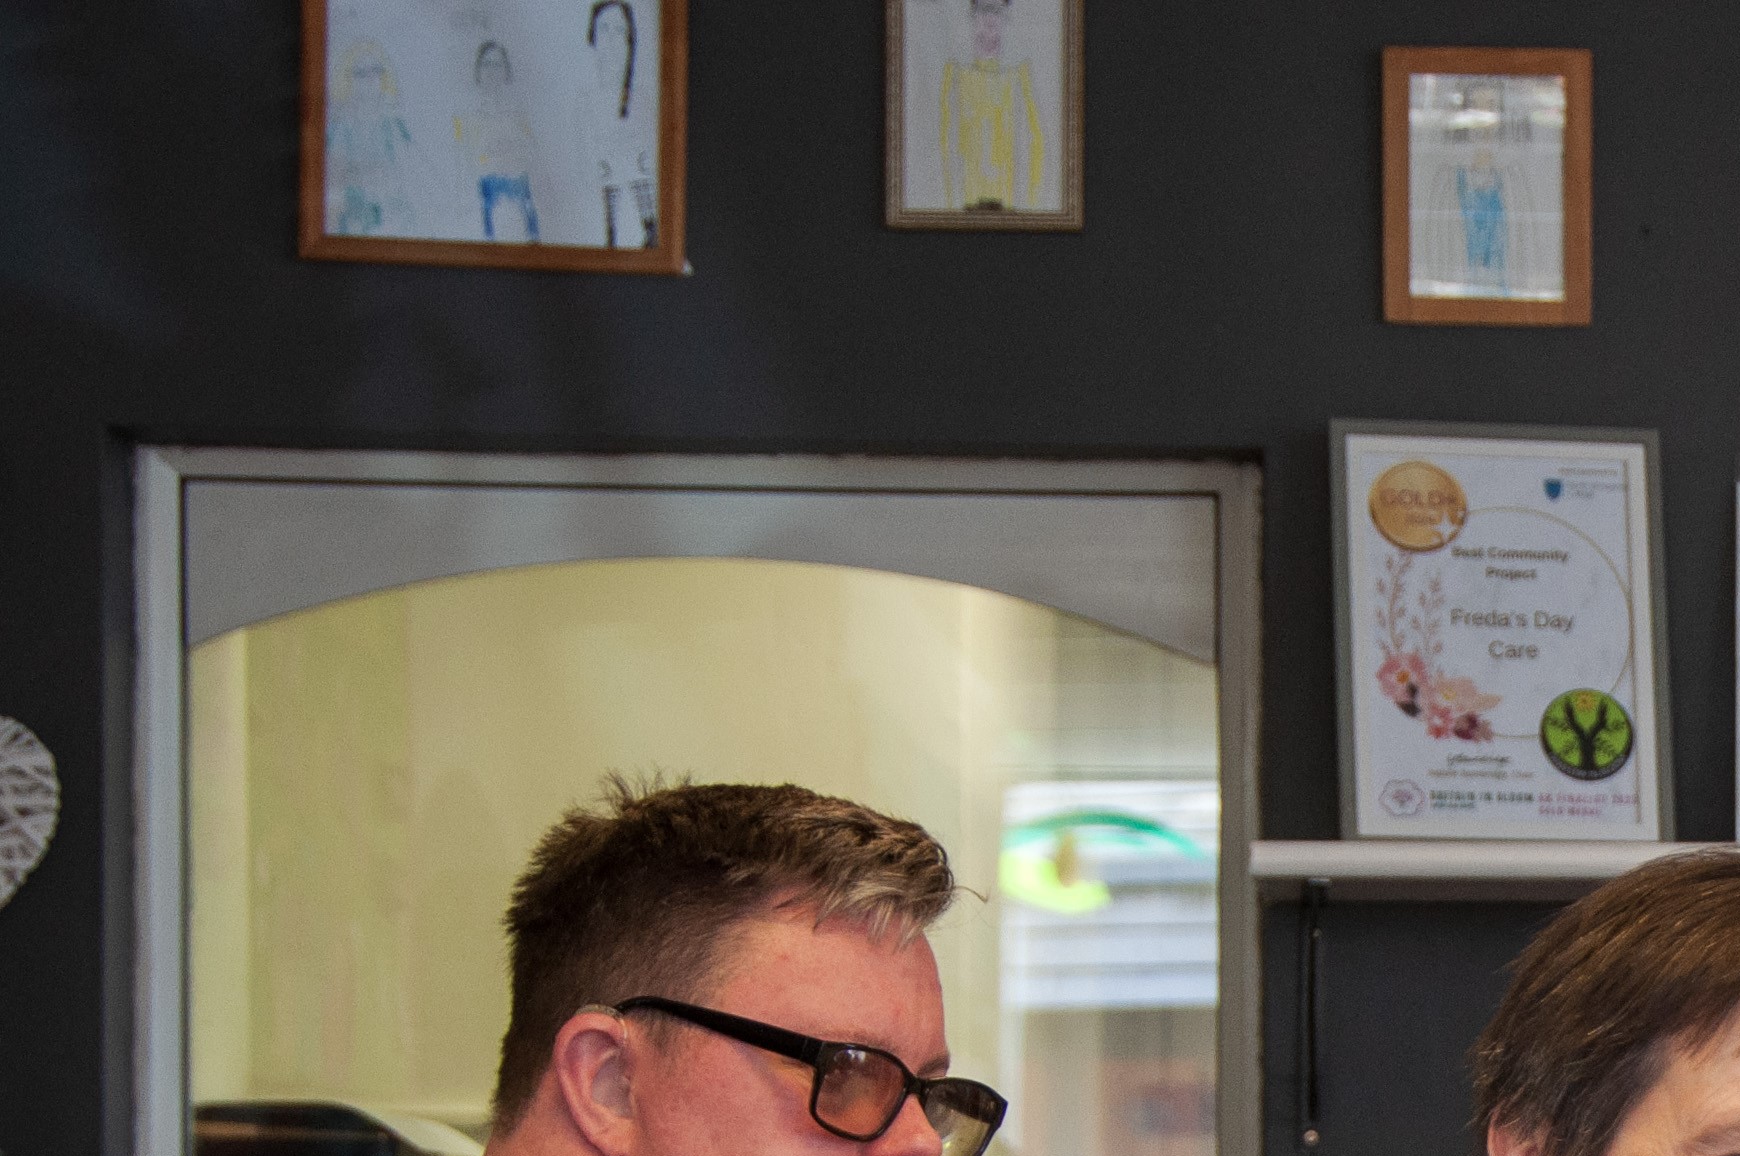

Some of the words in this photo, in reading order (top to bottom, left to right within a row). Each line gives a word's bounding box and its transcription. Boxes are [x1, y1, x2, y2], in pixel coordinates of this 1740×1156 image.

[1452, 548, 1484, 560] Best
[1488, 547, 1569, 563] Community
[1485, 567, 1537, 581] Project
[1450, 608, 1529, 629] Freda's
[1534, 610, 1575, 632] Day
[1489, 641, 1539, 659] Care
